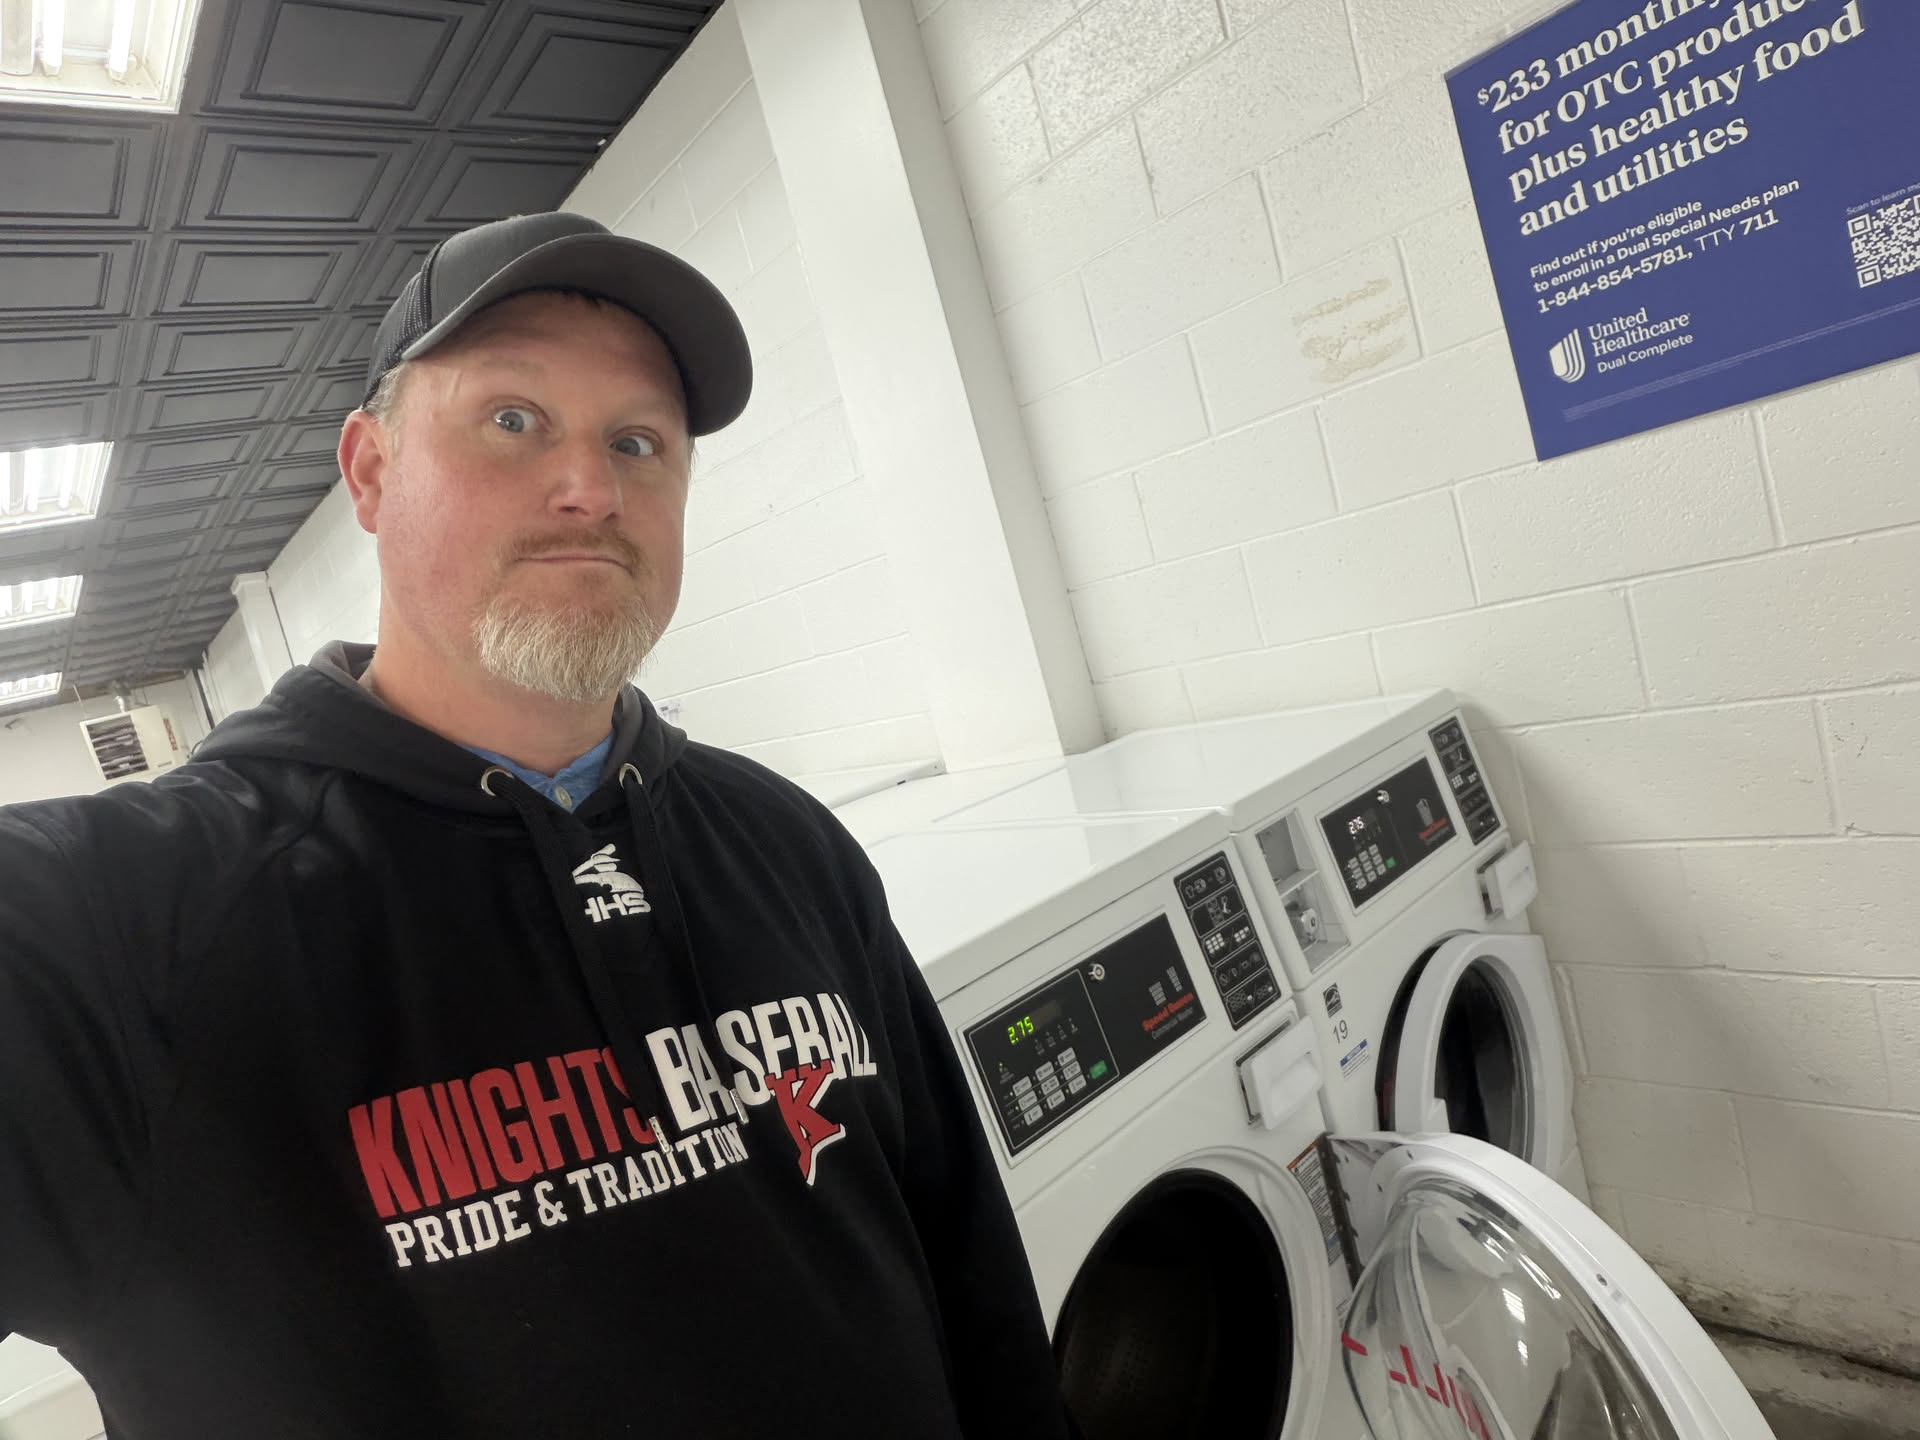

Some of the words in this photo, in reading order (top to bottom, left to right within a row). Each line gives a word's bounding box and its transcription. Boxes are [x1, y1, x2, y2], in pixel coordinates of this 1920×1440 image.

[1477, 58, 1551, 113] $233
[1498, 110, 1551, 154] for
[1557, 60, 1643, 123] OTC
[1508, 142, 1588, 203] plus
[1589, 64, 1745, 157] healthy
[1753, 1, 1865, 82] food
[1519, 180, 1590, 236] and
[1592, 117, 1749, 204] utilities
[1846, 202, 1870, 215] Scan
[1870, 198, 1881, 206] to
[1881, 188, 1907, 202] learn
[1530, 257, 1561, 278] Find
[1562, 247, 1587, 265] out
[1588, 240, 1599, 256] if
[1600, 228, 1646, 253] you're
[1647, 200, 1703, 230] eligible
[1533, 280, 1550, 293] to
[1551, 261, 1590, 287] enroll
[1591, 257, 1605, 271] in
[1606, 253, 1616, 265] a
[1617, 237, 1651, 261] Dual
[1652, 214, 1708, 247] Special
[1709, 195, 1761, 224] Needs
[1762, 179, 1800, 206] plan
[1537, 244, 1694, 314] 1-844-854-5781,
[1694, 223, 1736, 252] TTY
[1739, 209, 1779, 236] 711
[1588, 306, 1650, 341] United
[1592, 313, 1690, 357] Healthcare
[1597, 355, 1627, 374] Dual
[1628, 334, 1694, 363] Complete
[1007, 1016, 1034, 1045] 2.75
[1333, 1019, 1349, 1044] 19
[348, 1046, 657, 1219] KNIGHTS
[645, 992, 878, 1131] BASEBALL
[764, 1058, 847, 1187] K
[385, 1189, 532, 1268] PRIDE
[534, 1180, 568, 1227] &
[567, 1122, 750, 1215] TRADITION
